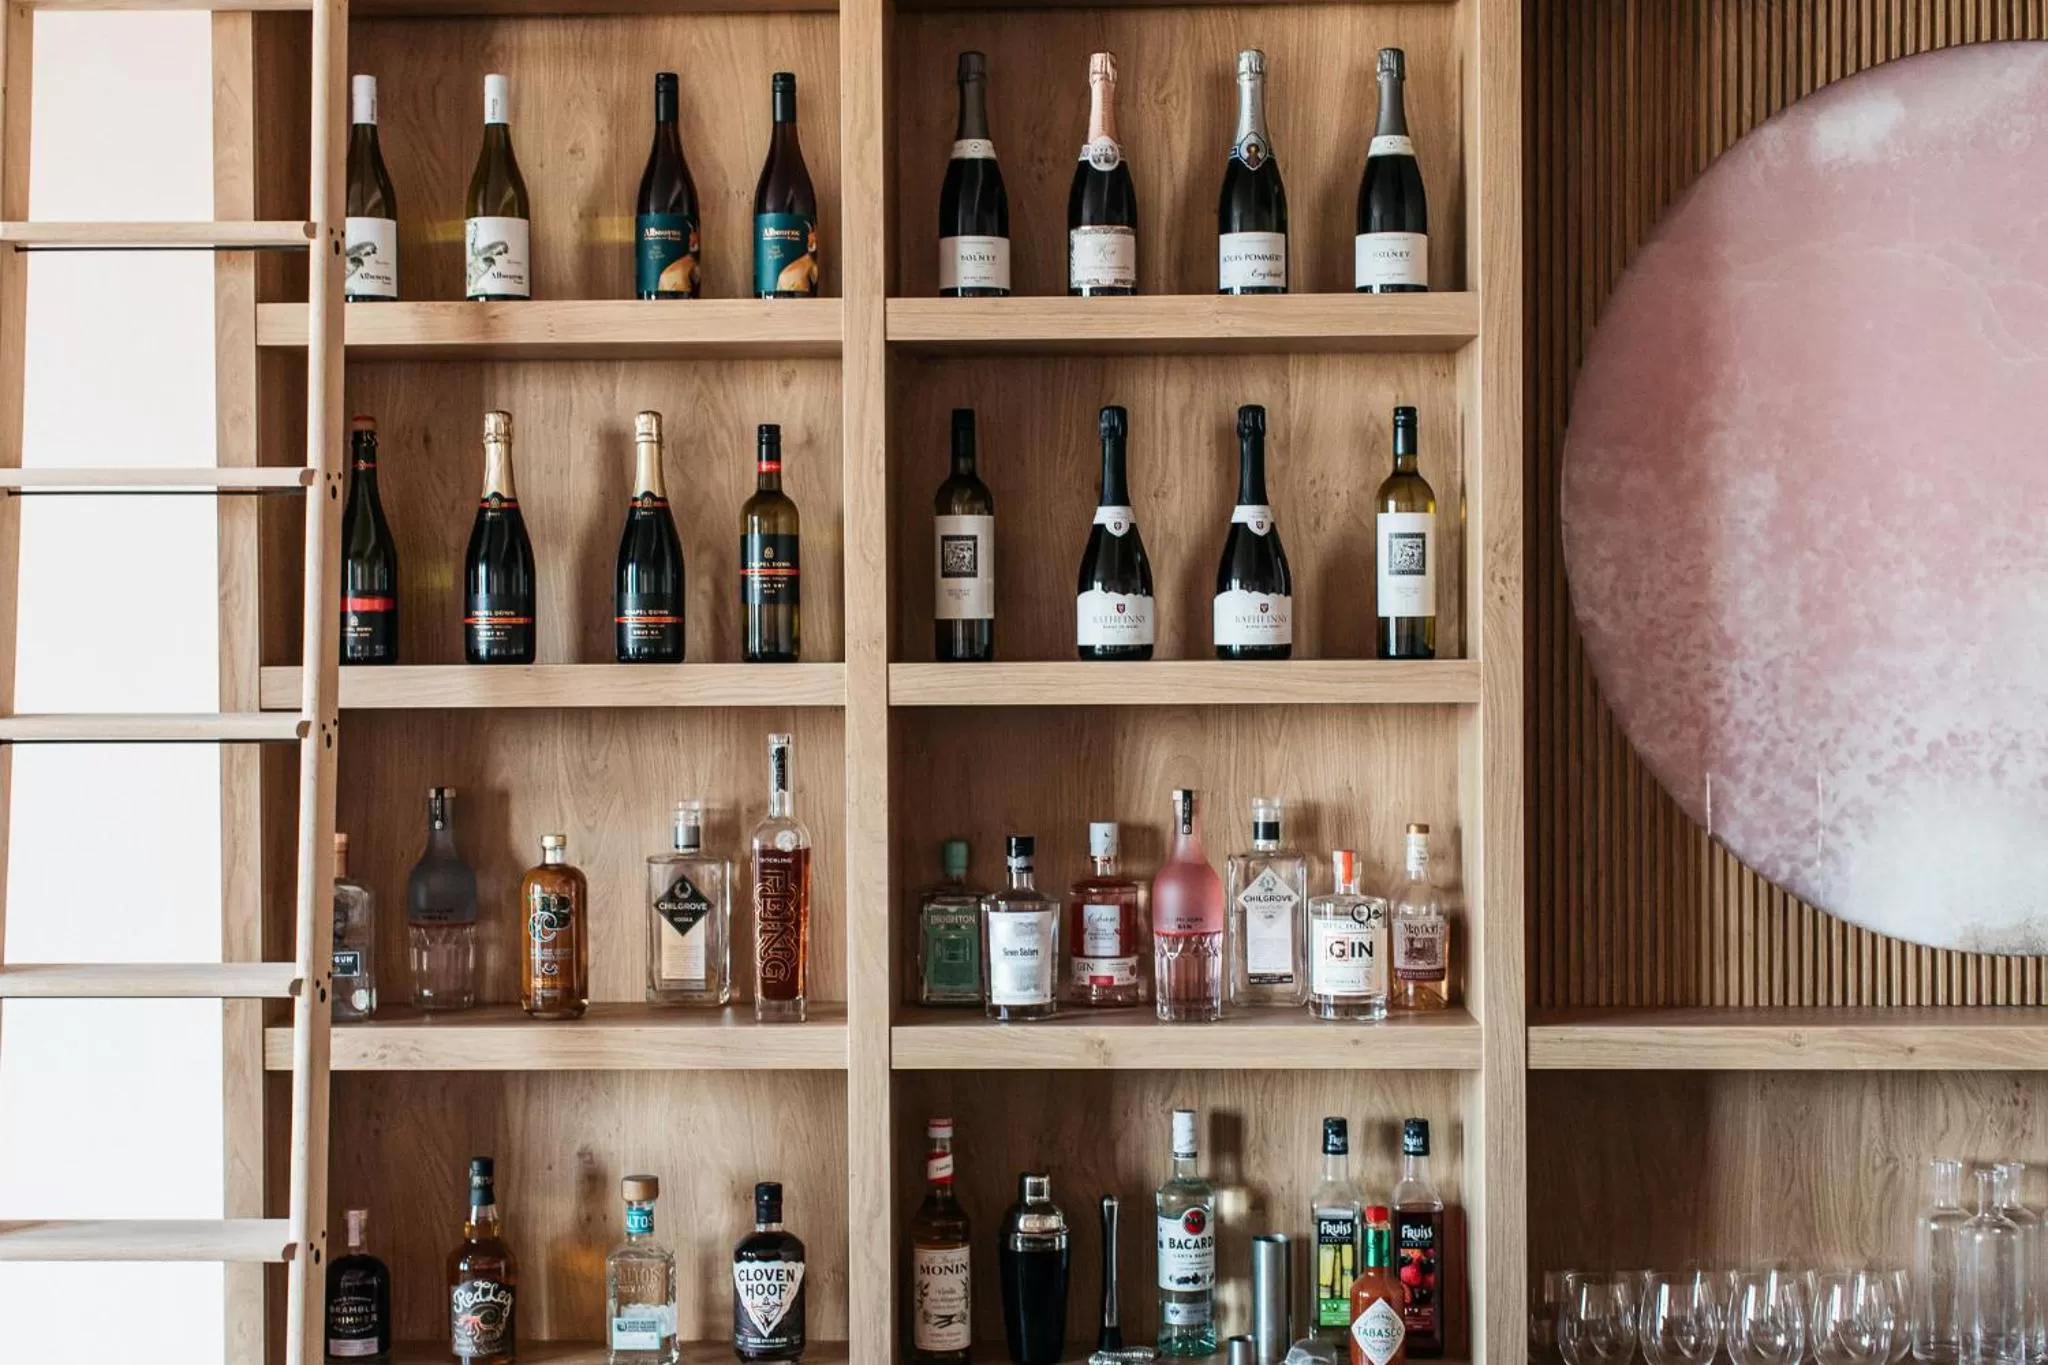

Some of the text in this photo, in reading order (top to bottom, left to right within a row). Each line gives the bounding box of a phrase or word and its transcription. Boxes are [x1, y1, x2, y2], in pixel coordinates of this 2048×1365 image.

[1243, 894, 1293, 903] CHILGROVE
[658, 902, 708, 910] CHILGROVE
[1329, 941, 1373, 958] GIN
[738, 1268, 795, 1281] CLOVEN
[919, 1263, 968, 1276] MONIN
[745, 1284, 788, 1300] HOOF
[1356, 1326, 1401, 1338] TABASCO
